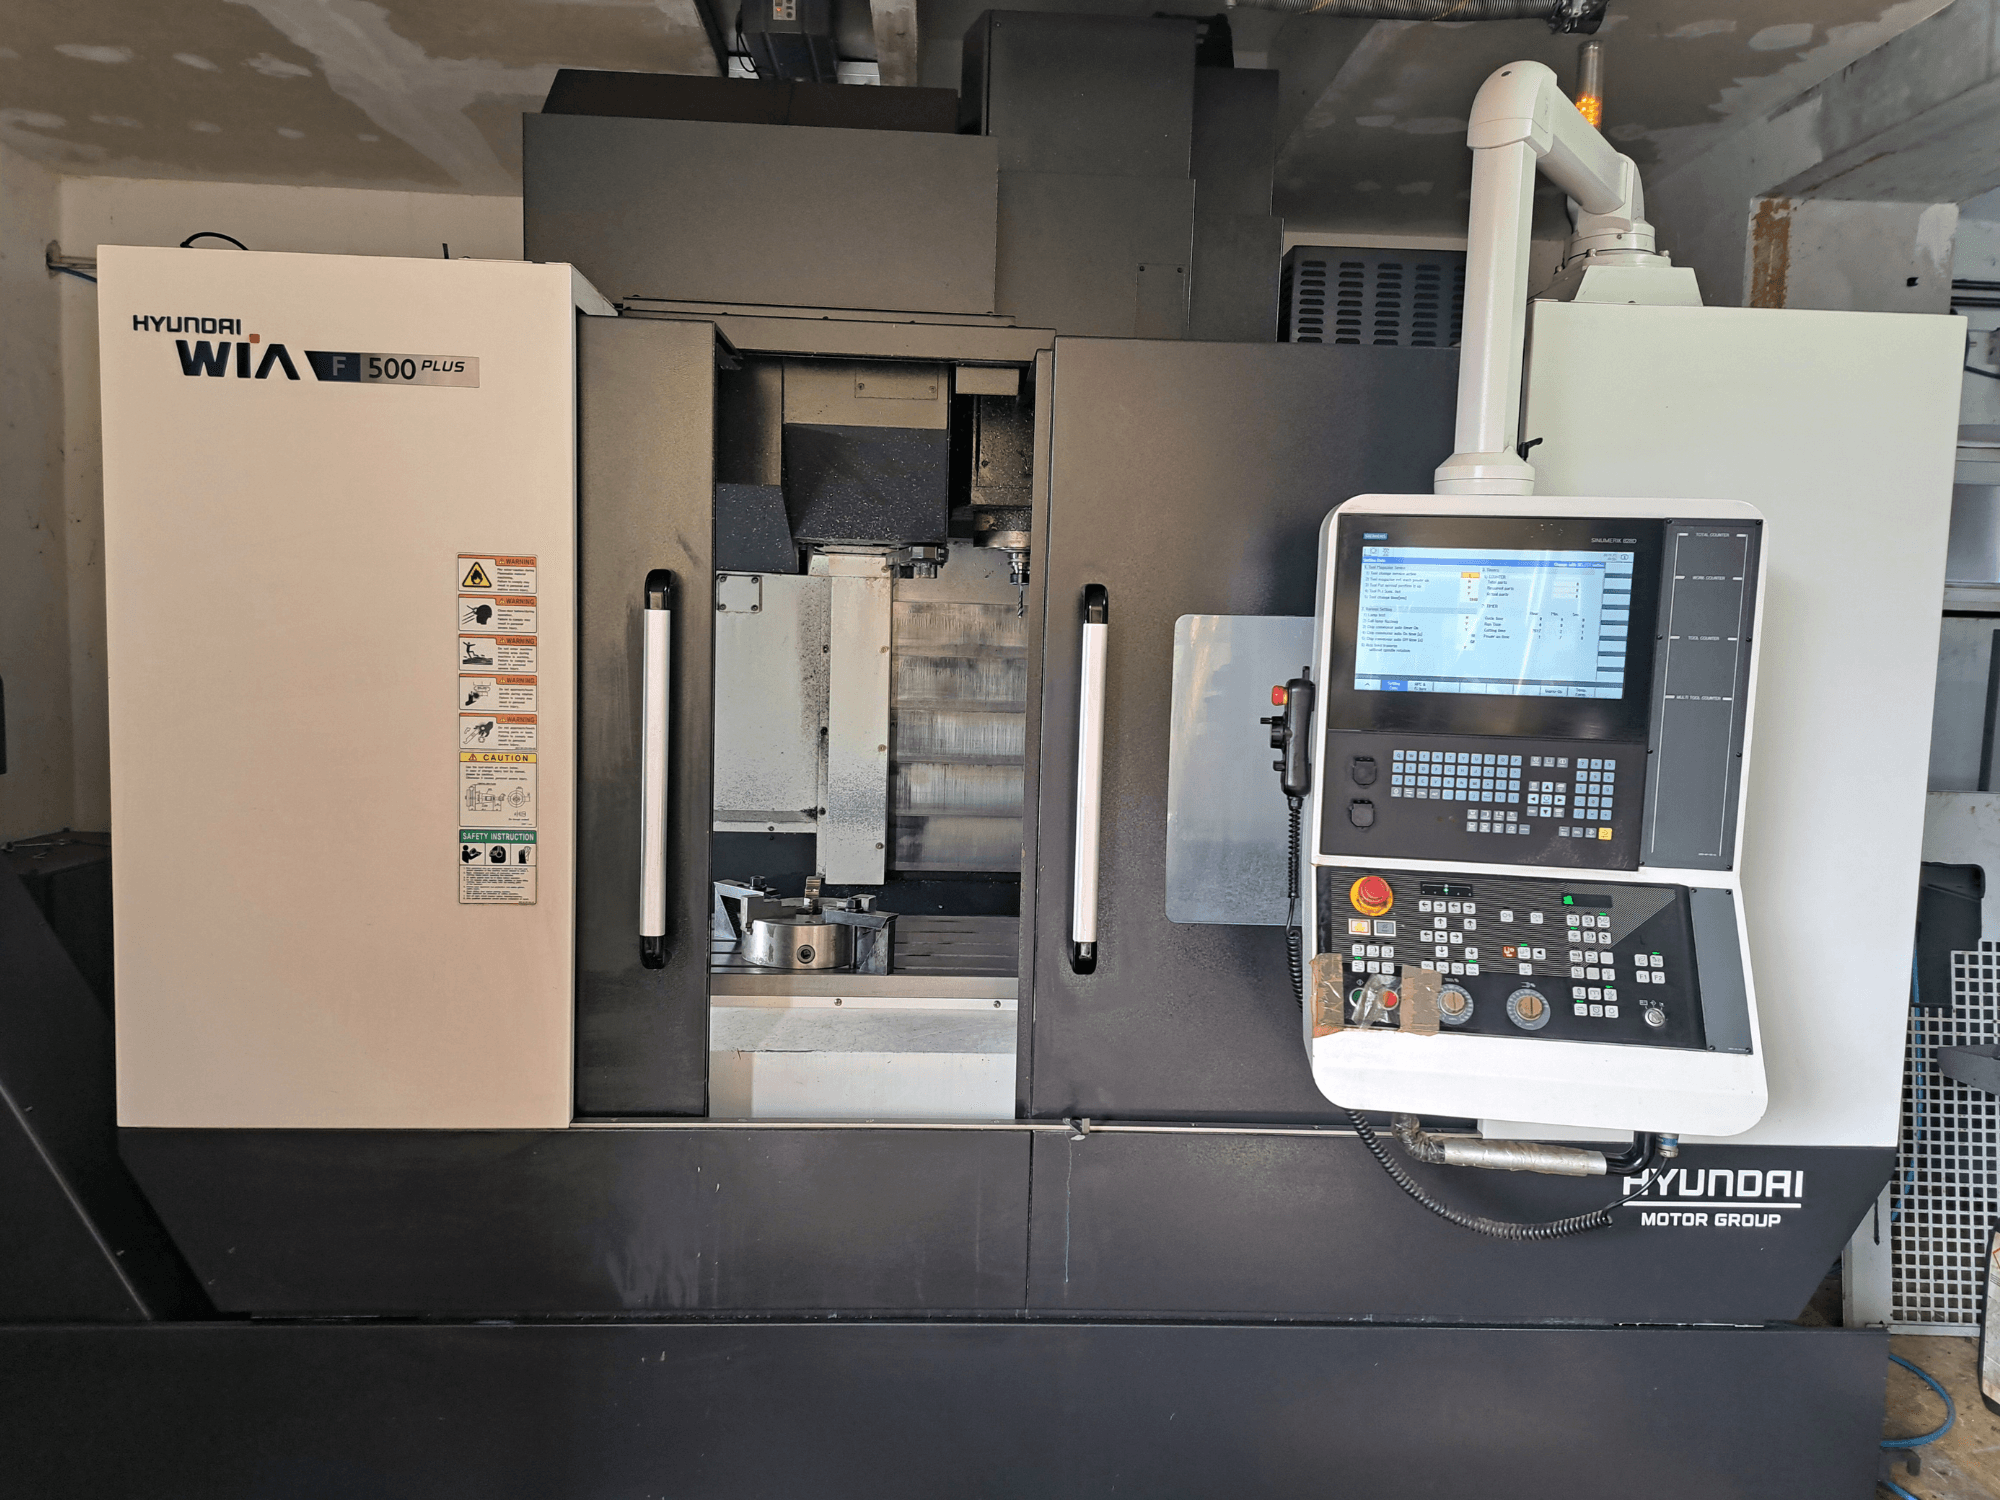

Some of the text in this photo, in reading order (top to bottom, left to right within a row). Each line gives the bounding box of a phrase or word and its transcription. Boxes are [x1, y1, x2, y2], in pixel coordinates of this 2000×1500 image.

[133, 315, 241, 335] HYUNDAI
[175, 334, 465, 380] WIA F 500 PLUS
[483, 754, 529, 762] CAUTION
[463, 832, 534, 841] SAFETY INSTRUCTION
[1622, 1169, 1804, 1198] HYUNDAI
[1641, 1212, 1781, 1228] MOTOR GROUP
